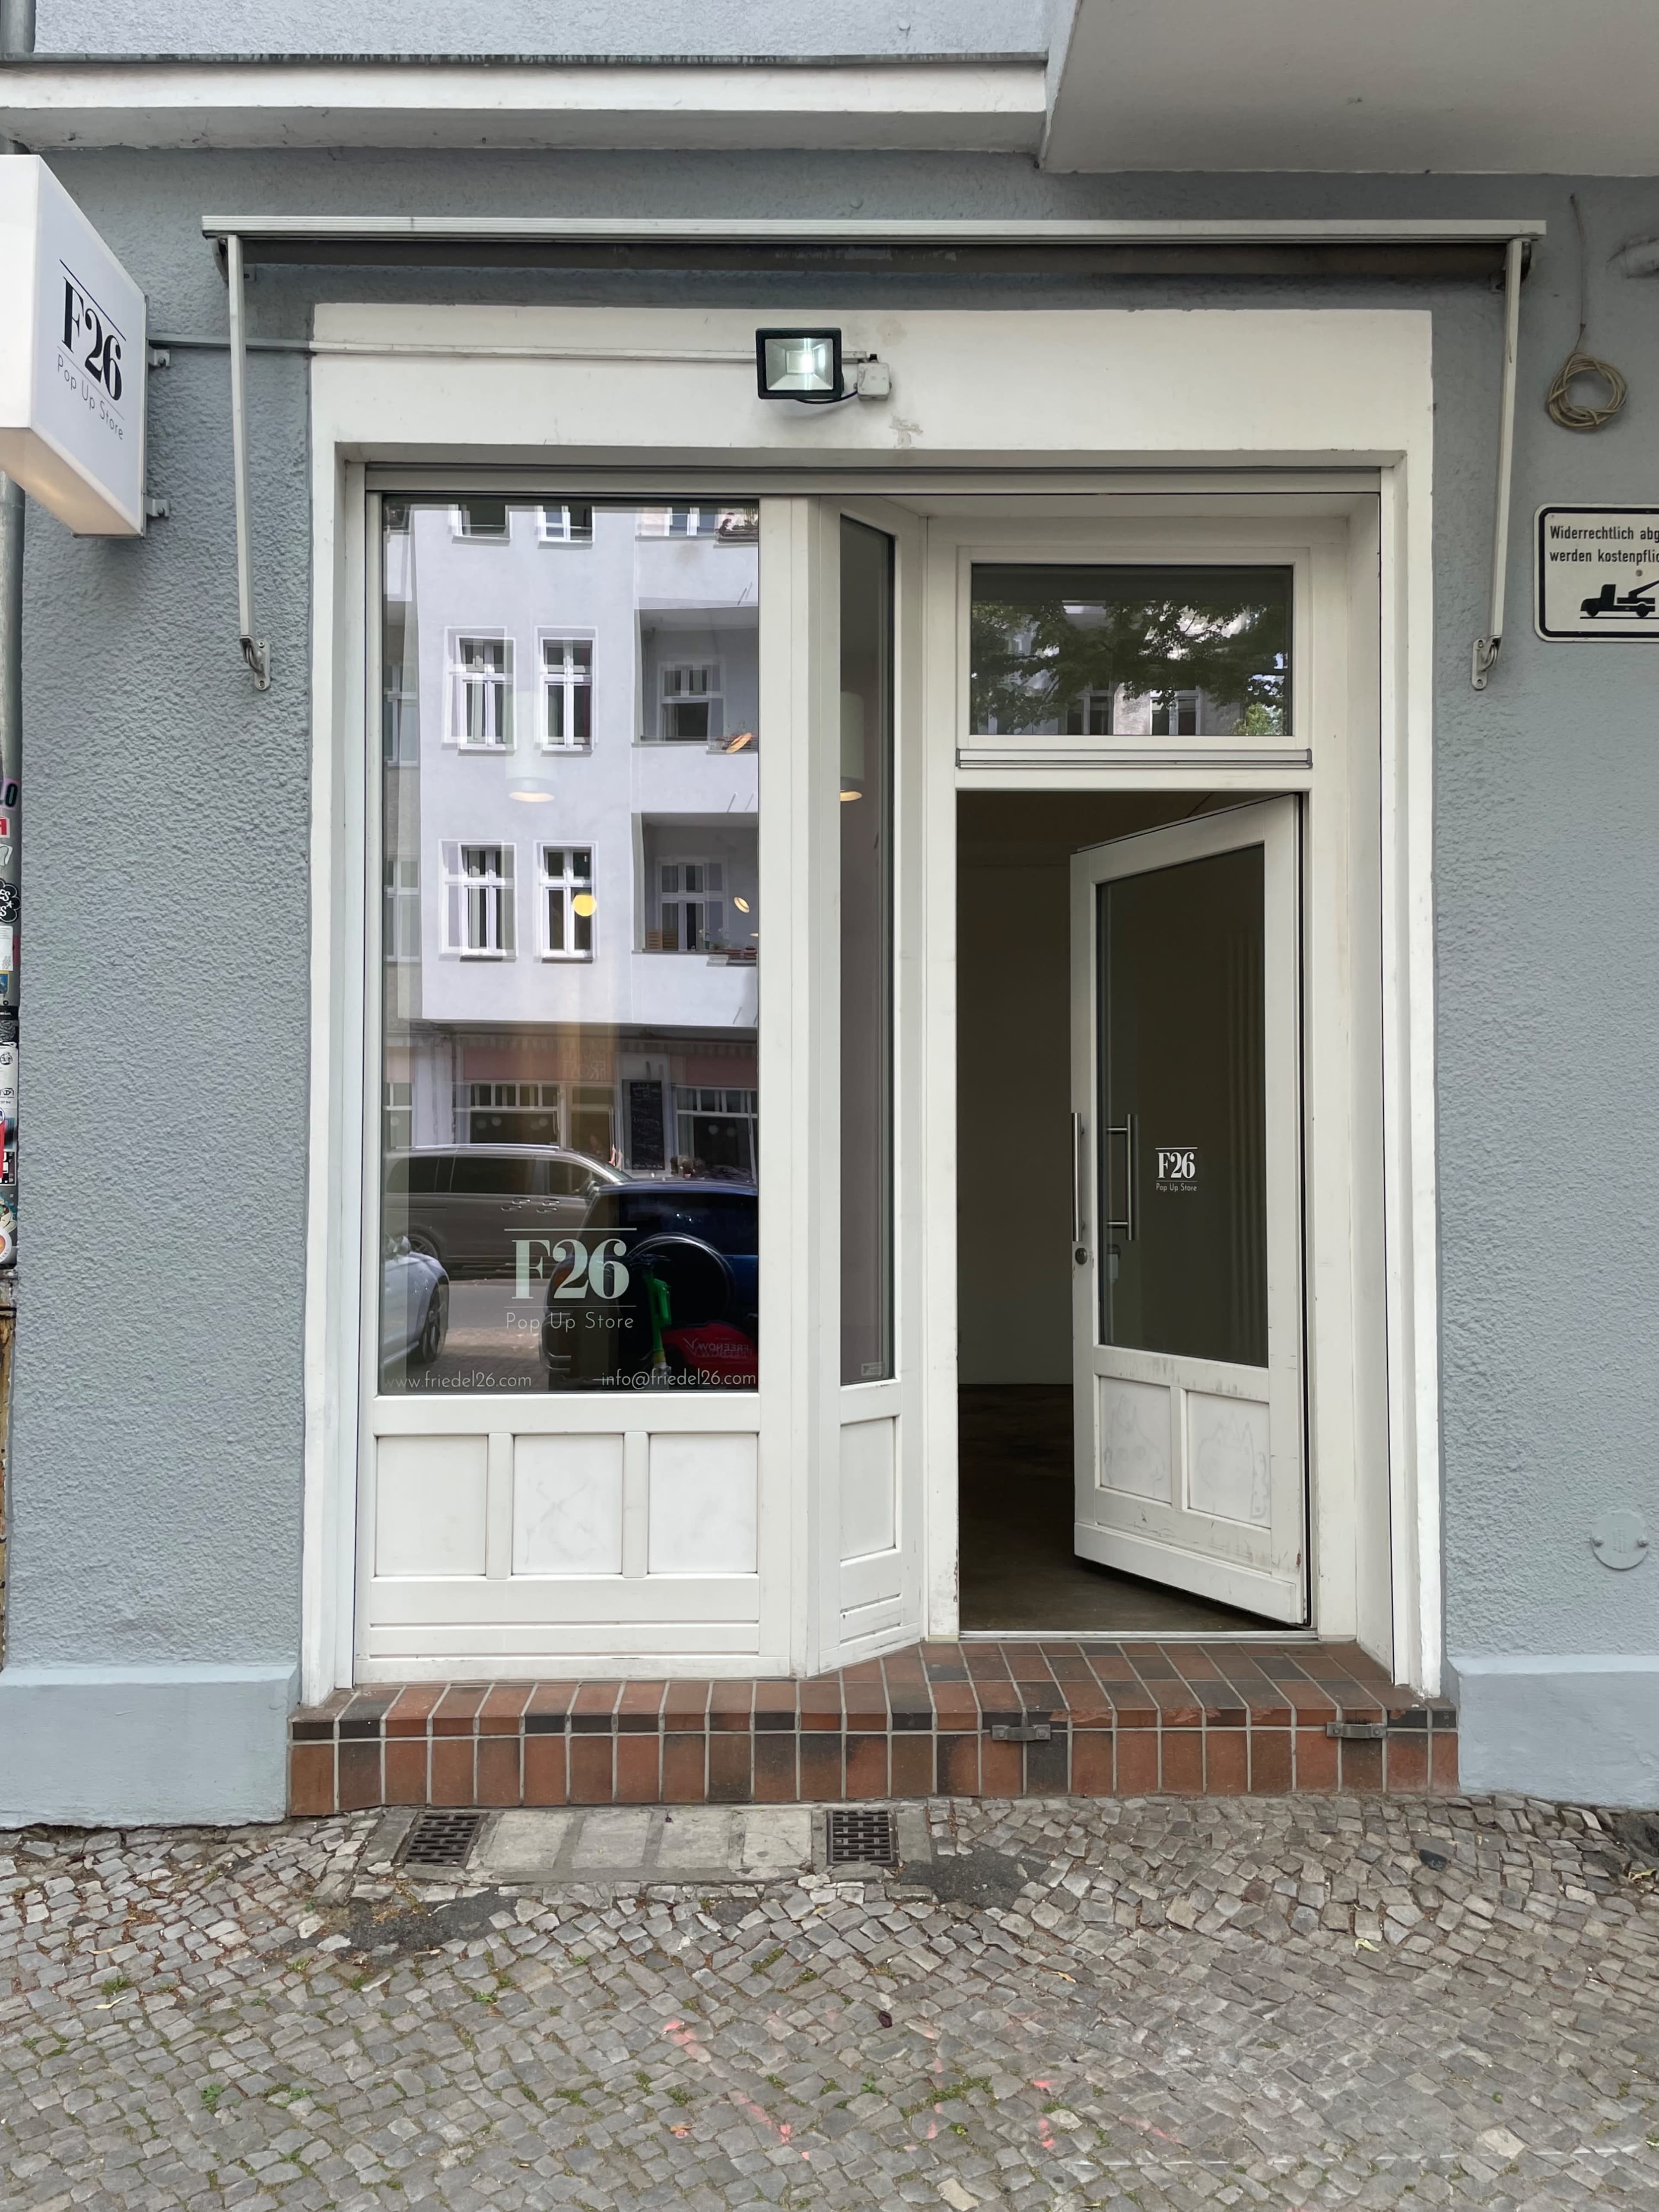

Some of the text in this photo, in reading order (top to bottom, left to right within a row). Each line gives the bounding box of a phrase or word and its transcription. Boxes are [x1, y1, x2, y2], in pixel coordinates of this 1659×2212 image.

[62, 276, 122, 400] F26
[57, 354, 123, 440] Pop Up Store
[1550, 526, 1634, 540] Widerrechtlich
[1550, 548, 1592, 562] werden
[1158, 1152, 1195, 1179] F26
[1156, 1183, 1197, 1192] Pop Up Store
[512, 1239, 629, 1299] F26
[506, 1312, 634, 1332] Pop Up Store
[384, 1370, 532, 1388] www.friedel26.com
[602, 1368, 756, 1390] info@friedel26.com
